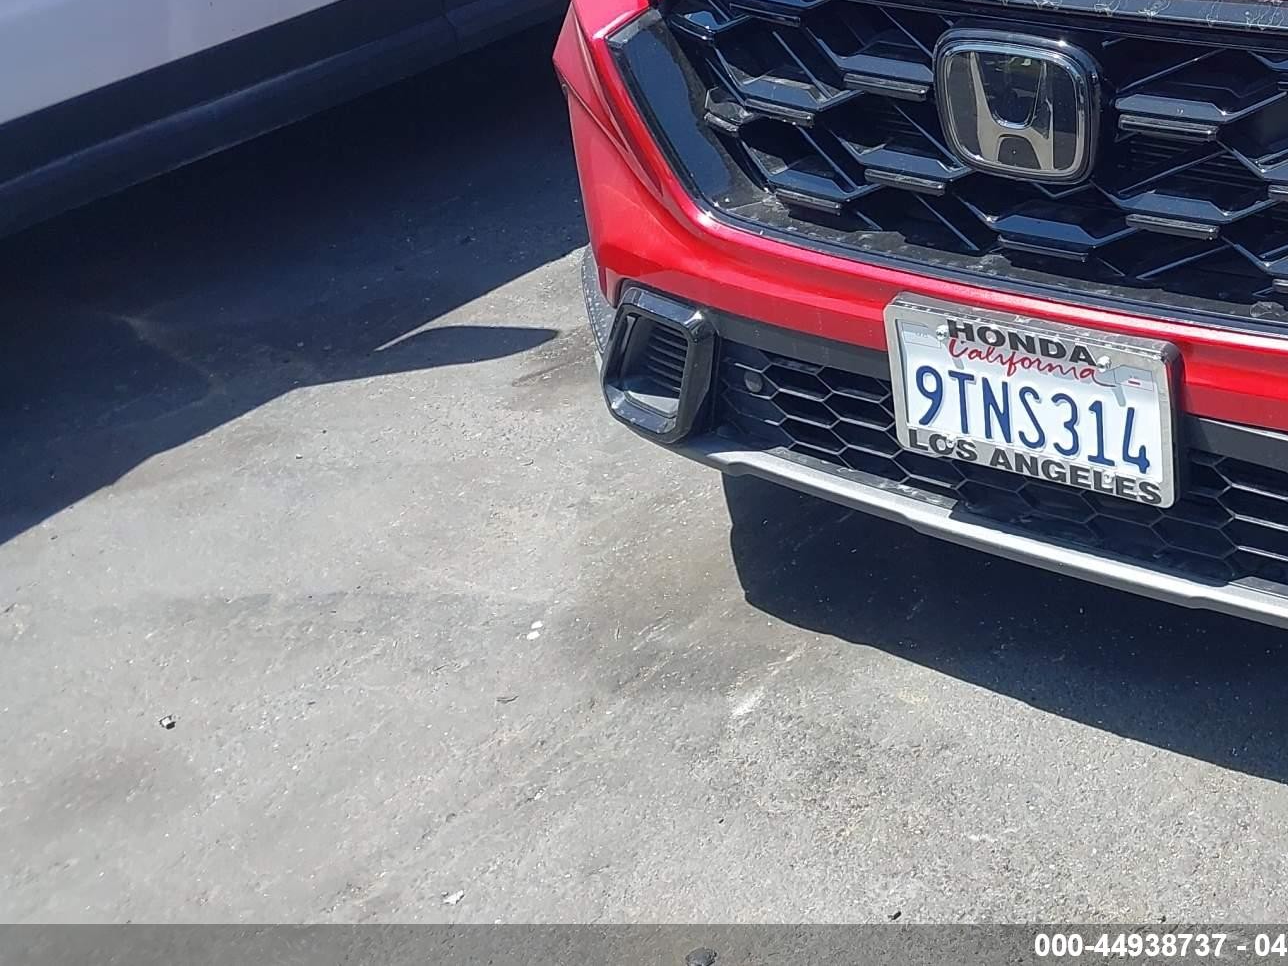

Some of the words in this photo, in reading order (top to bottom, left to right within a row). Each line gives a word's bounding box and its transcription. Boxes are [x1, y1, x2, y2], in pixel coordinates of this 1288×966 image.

[947, 319, 1097, 365] HONDA
[915, 365, 1150, 474] 9TNS314
[908, 428, 978, 462] LOS
[990, 447, 1162, 505] ANGELES
